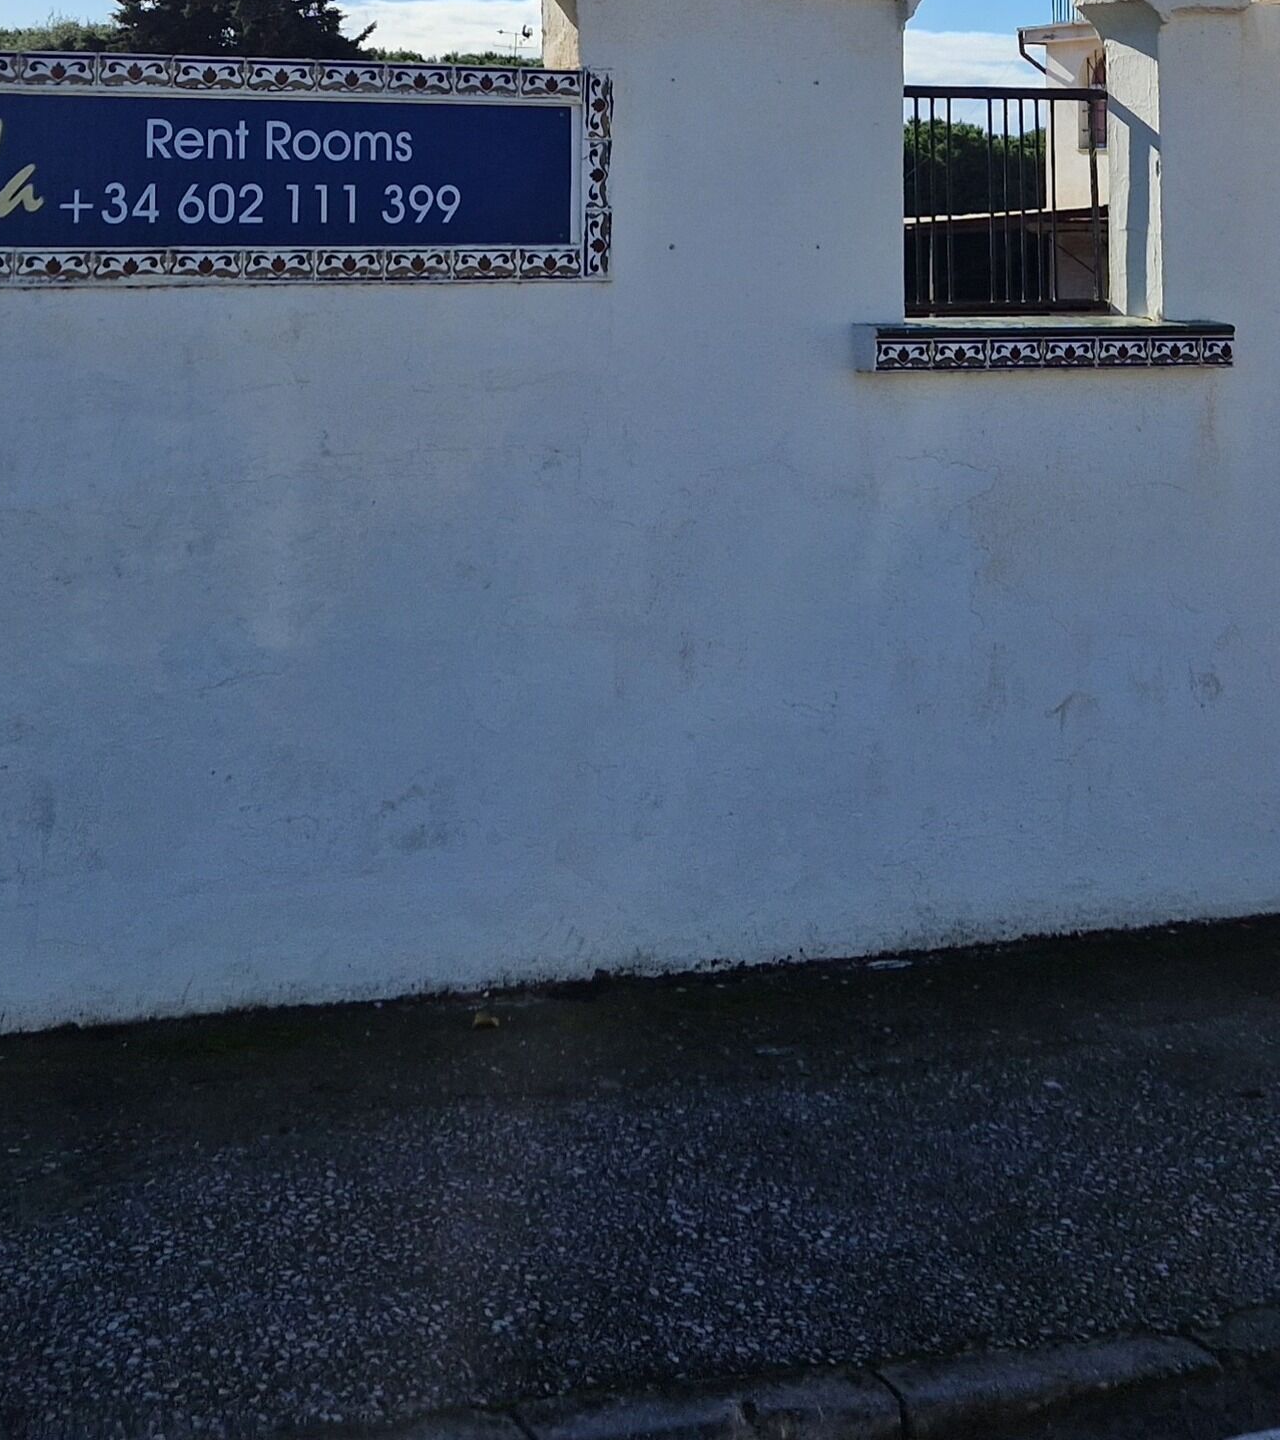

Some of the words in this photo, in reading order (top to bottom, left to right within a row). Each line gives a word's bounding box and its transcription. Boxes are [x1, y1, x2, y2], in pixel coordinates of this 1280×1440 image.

[145, 118, 250, 160] Rent
[265, 119, 414, 162] Rooms
[58, 183, 160, 225] +34
[177, 183, 264, 225] 602
[286, 184, 358, 224] 111
[380, 184, 461, 225] 399
